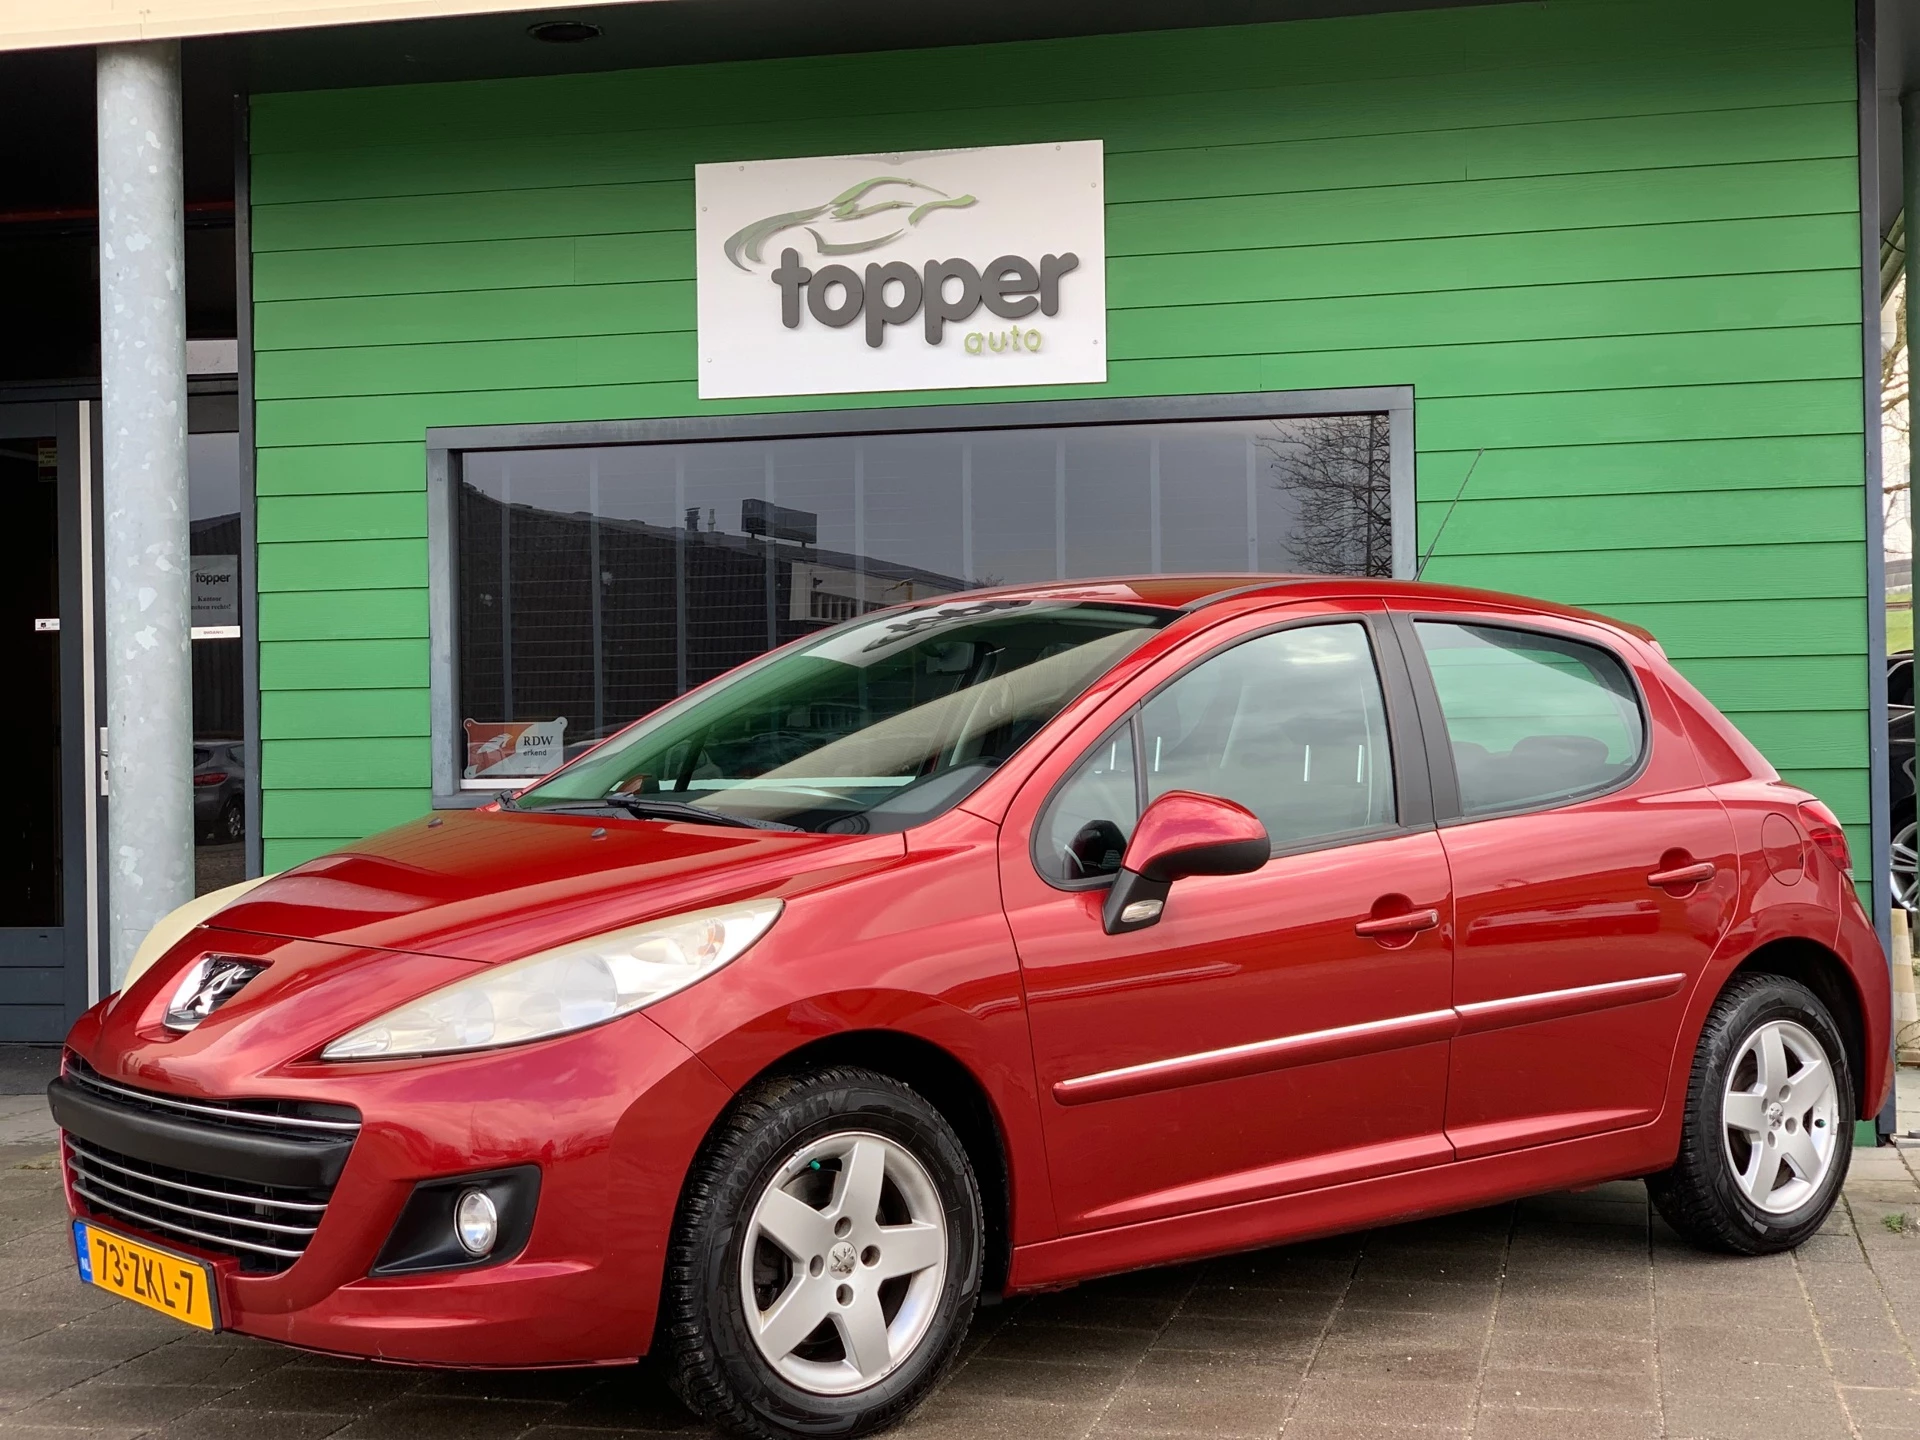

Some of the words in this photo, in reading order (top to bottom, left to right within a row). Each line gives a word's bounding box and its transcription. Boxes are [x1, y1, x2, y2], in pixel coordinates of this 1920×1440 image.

[770, 246, 1079, 348] topper
[964, 324, 1042, 355] auto
[195, 572, 231, 585] topper
[523, 735, 554, 746] RDW
[523, 749, 547, 757] erkend
[81, 1257, 92, 1272] NL
[96, 1238, 194, 1314] 73-ZKL-7
